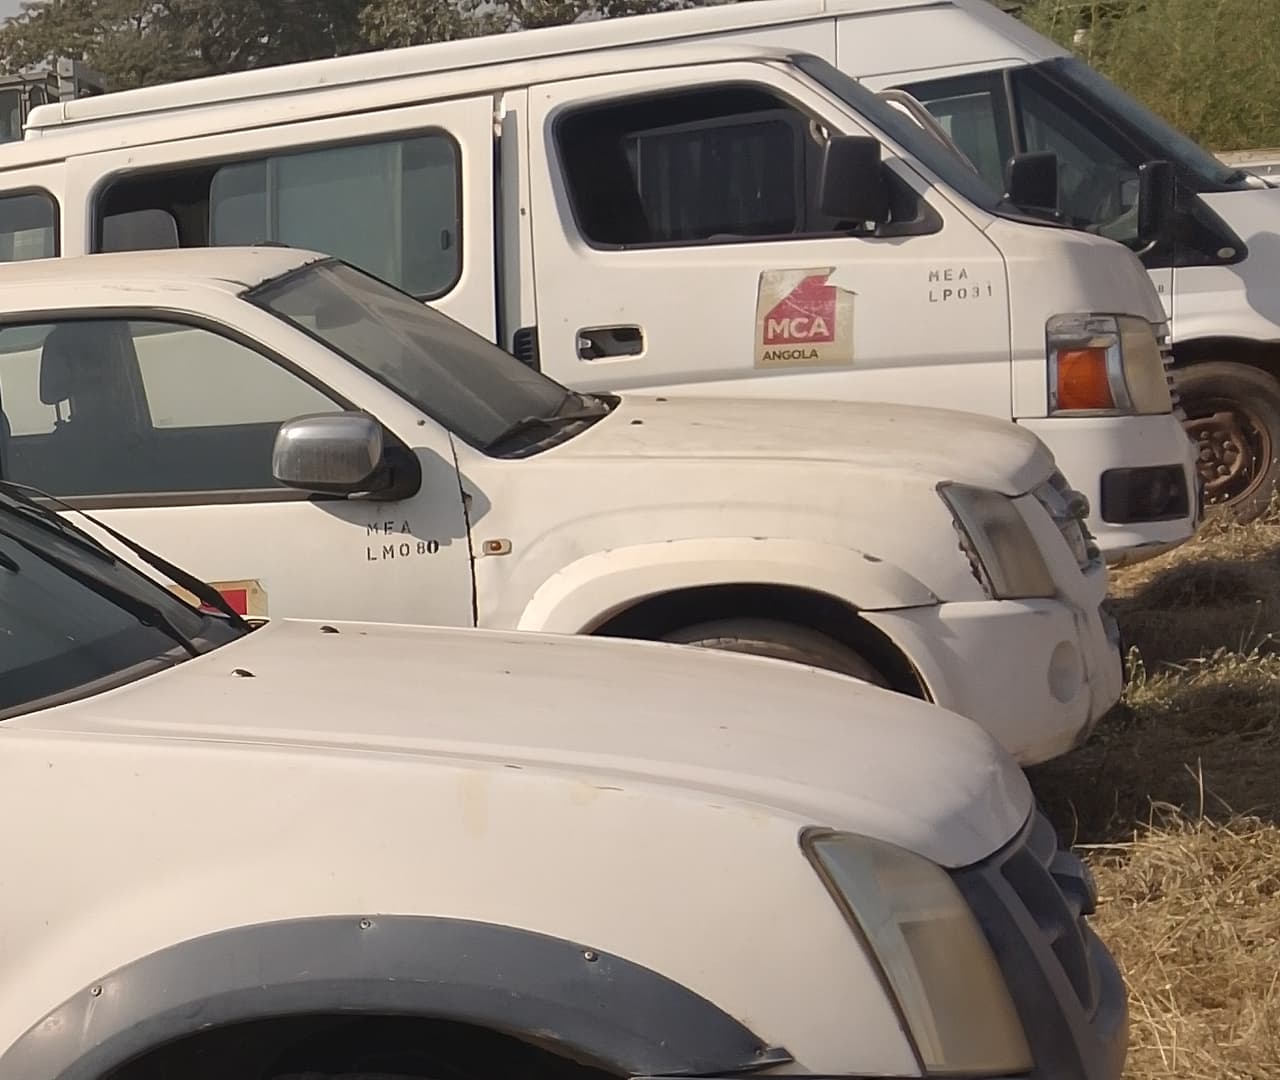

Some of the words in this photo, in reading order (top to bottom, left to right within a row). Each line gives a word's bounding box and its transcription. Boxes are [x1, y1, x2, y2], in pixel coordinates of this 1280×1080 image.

[928, 269, 968, 282] MEA
[767, 318, 829, 340] MCA
[762, 348, 819, 361] ANGOLA
[367, 521, 412, 536] MEA
